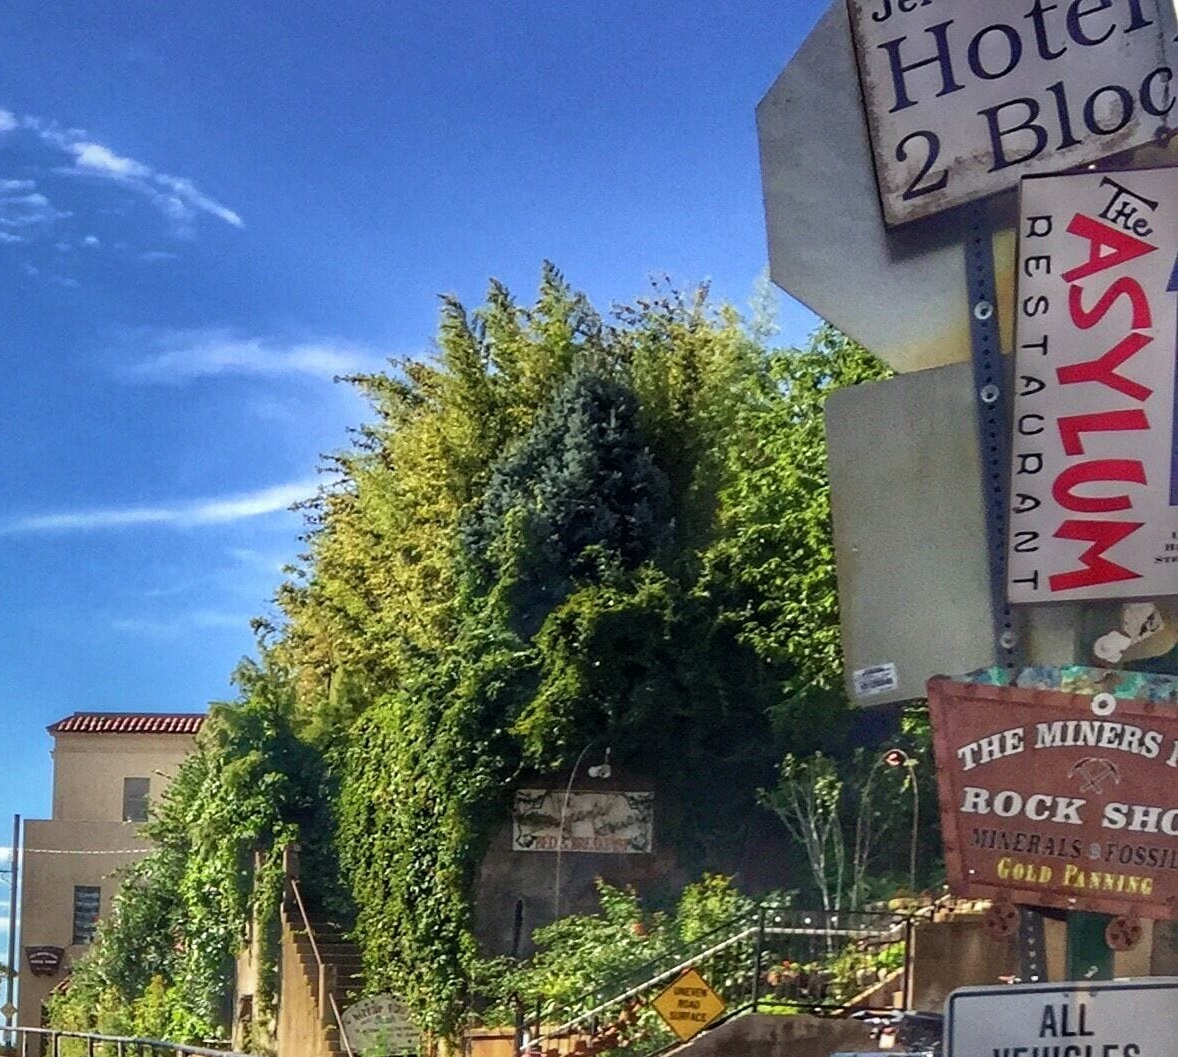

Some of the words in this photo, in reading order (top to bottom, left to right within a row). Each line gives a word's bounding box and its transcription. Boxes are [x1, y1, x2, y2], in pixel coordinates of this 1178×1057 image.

[894, 130, 949, 201] 2
[977, 66, 1177, 173] Bloc
[1012, 214, 1052, 590] RESTAURANT
[1049, 212, 1159, 592] ASYLUM
[957, 728, 1024, 771] THE
[1034, 720, 1163, 759] MINERS
[960, 787, 1086, 825] ROCK
[970, 828, 1082, 860] MINERALS
[997, 857, 1053, 884] GOLD
[1039, 1003, 1094, 1038] ALL
